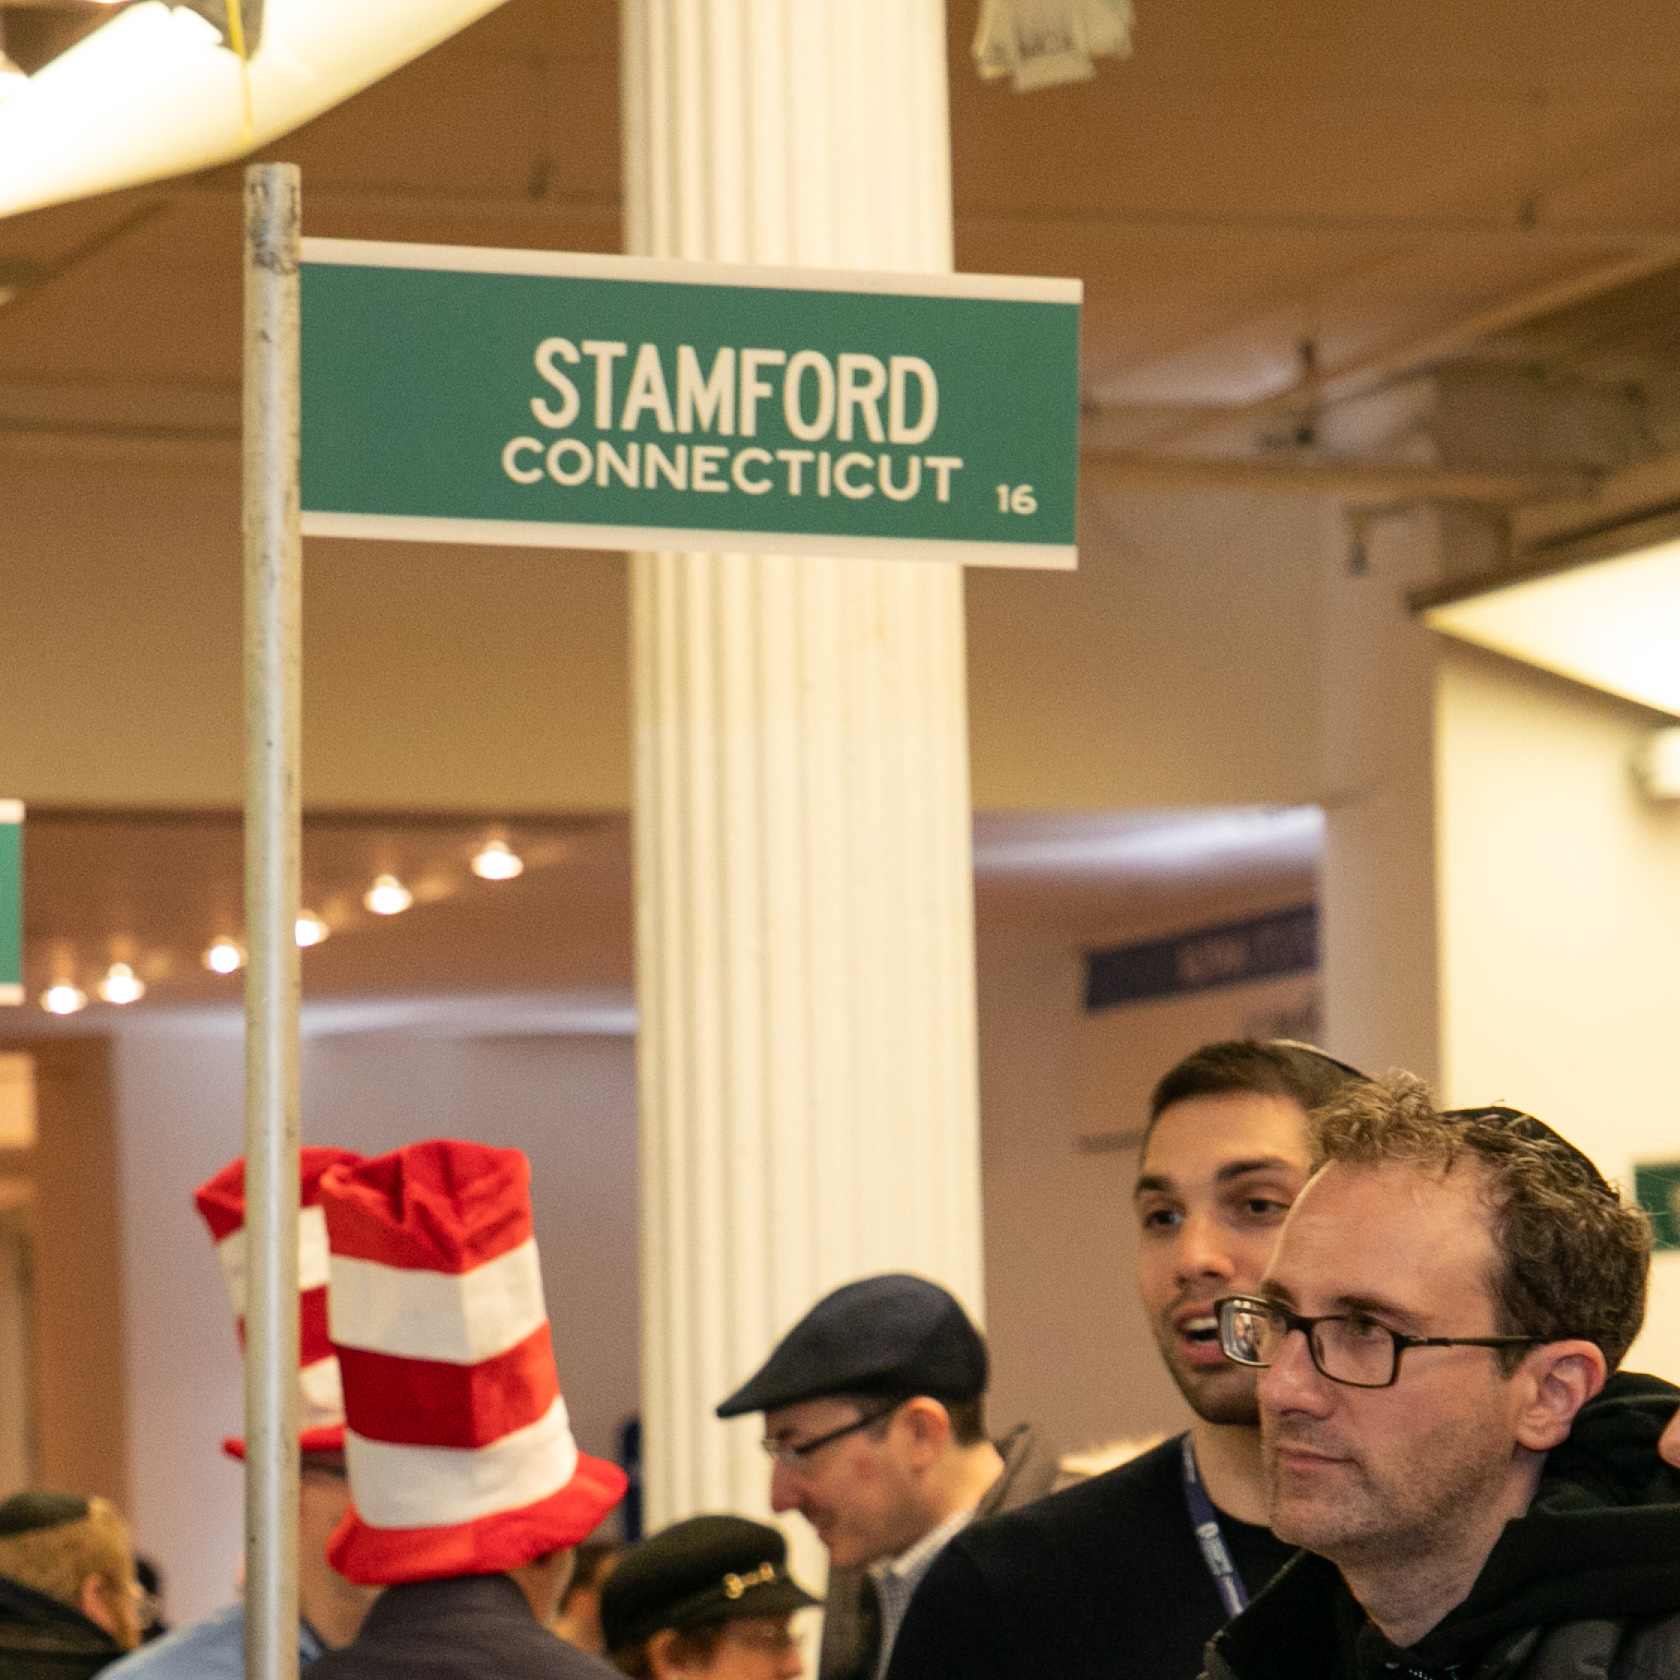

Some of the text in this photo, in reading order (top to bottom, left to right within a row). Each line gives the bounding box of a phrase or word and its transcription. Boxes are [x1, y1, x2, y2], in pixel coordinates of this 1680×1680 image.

[530, 336, 938, 444] STAMFORD
[501, 437, 965, 503] CONNECTICUT
[997, 484, 1037, 515] 16
